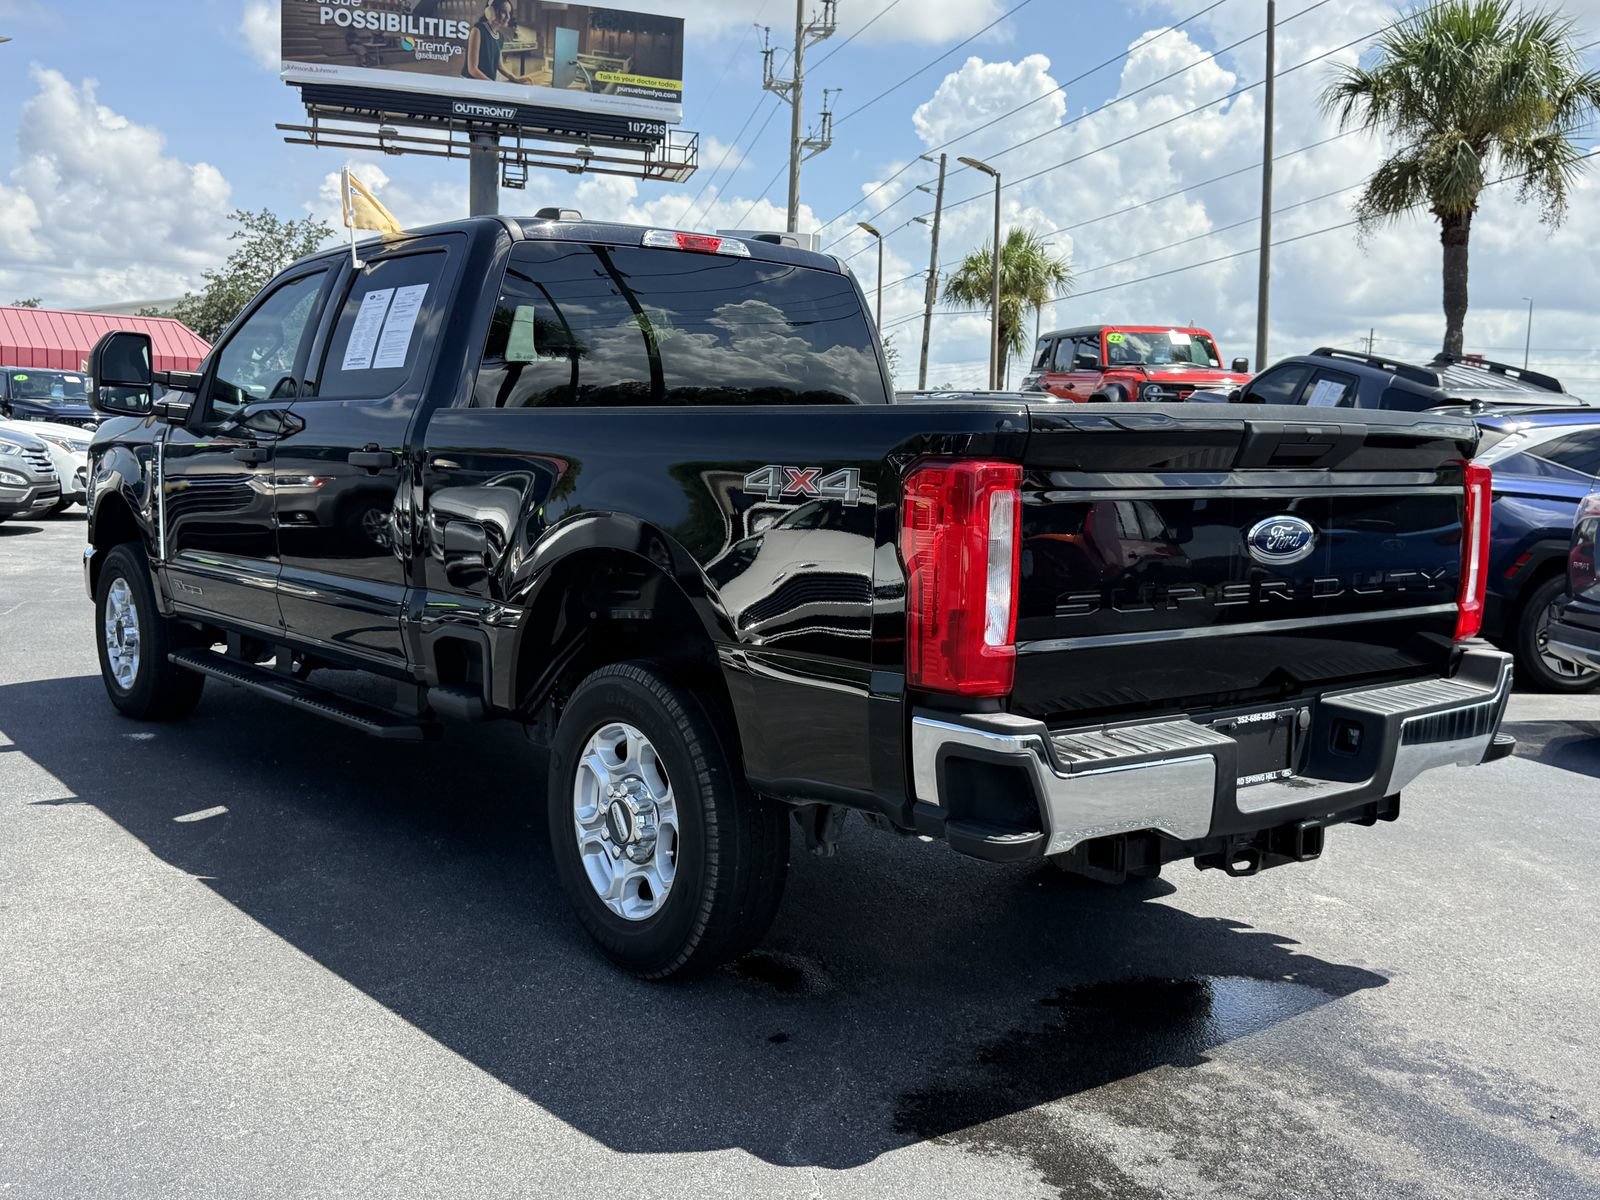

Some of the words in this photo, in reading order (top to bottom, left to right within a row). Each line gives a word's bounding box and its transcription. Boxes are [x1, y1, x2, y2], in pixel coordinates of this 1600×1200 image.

[320, 6, 470, 40] POSSIBILITIES
[415, 38, 463, 56] Tremfya
[621, 76, 635, 84] your
[637, 77, 657, 85] doctor
[617, 86, 678, 98] pursuetremfya.com
[627, 121, 666, 135] 10729S
[1110, 334, 1121, 342] 22
[1266, 525, 1303, 550] Ford
[1054, 580, 1297, 618] SUPER
[1311, 566, 1447, 599] DUTY
[1245, 774, 1265, 784] SPRING
[1265, 772, 1277, 781] HILL
